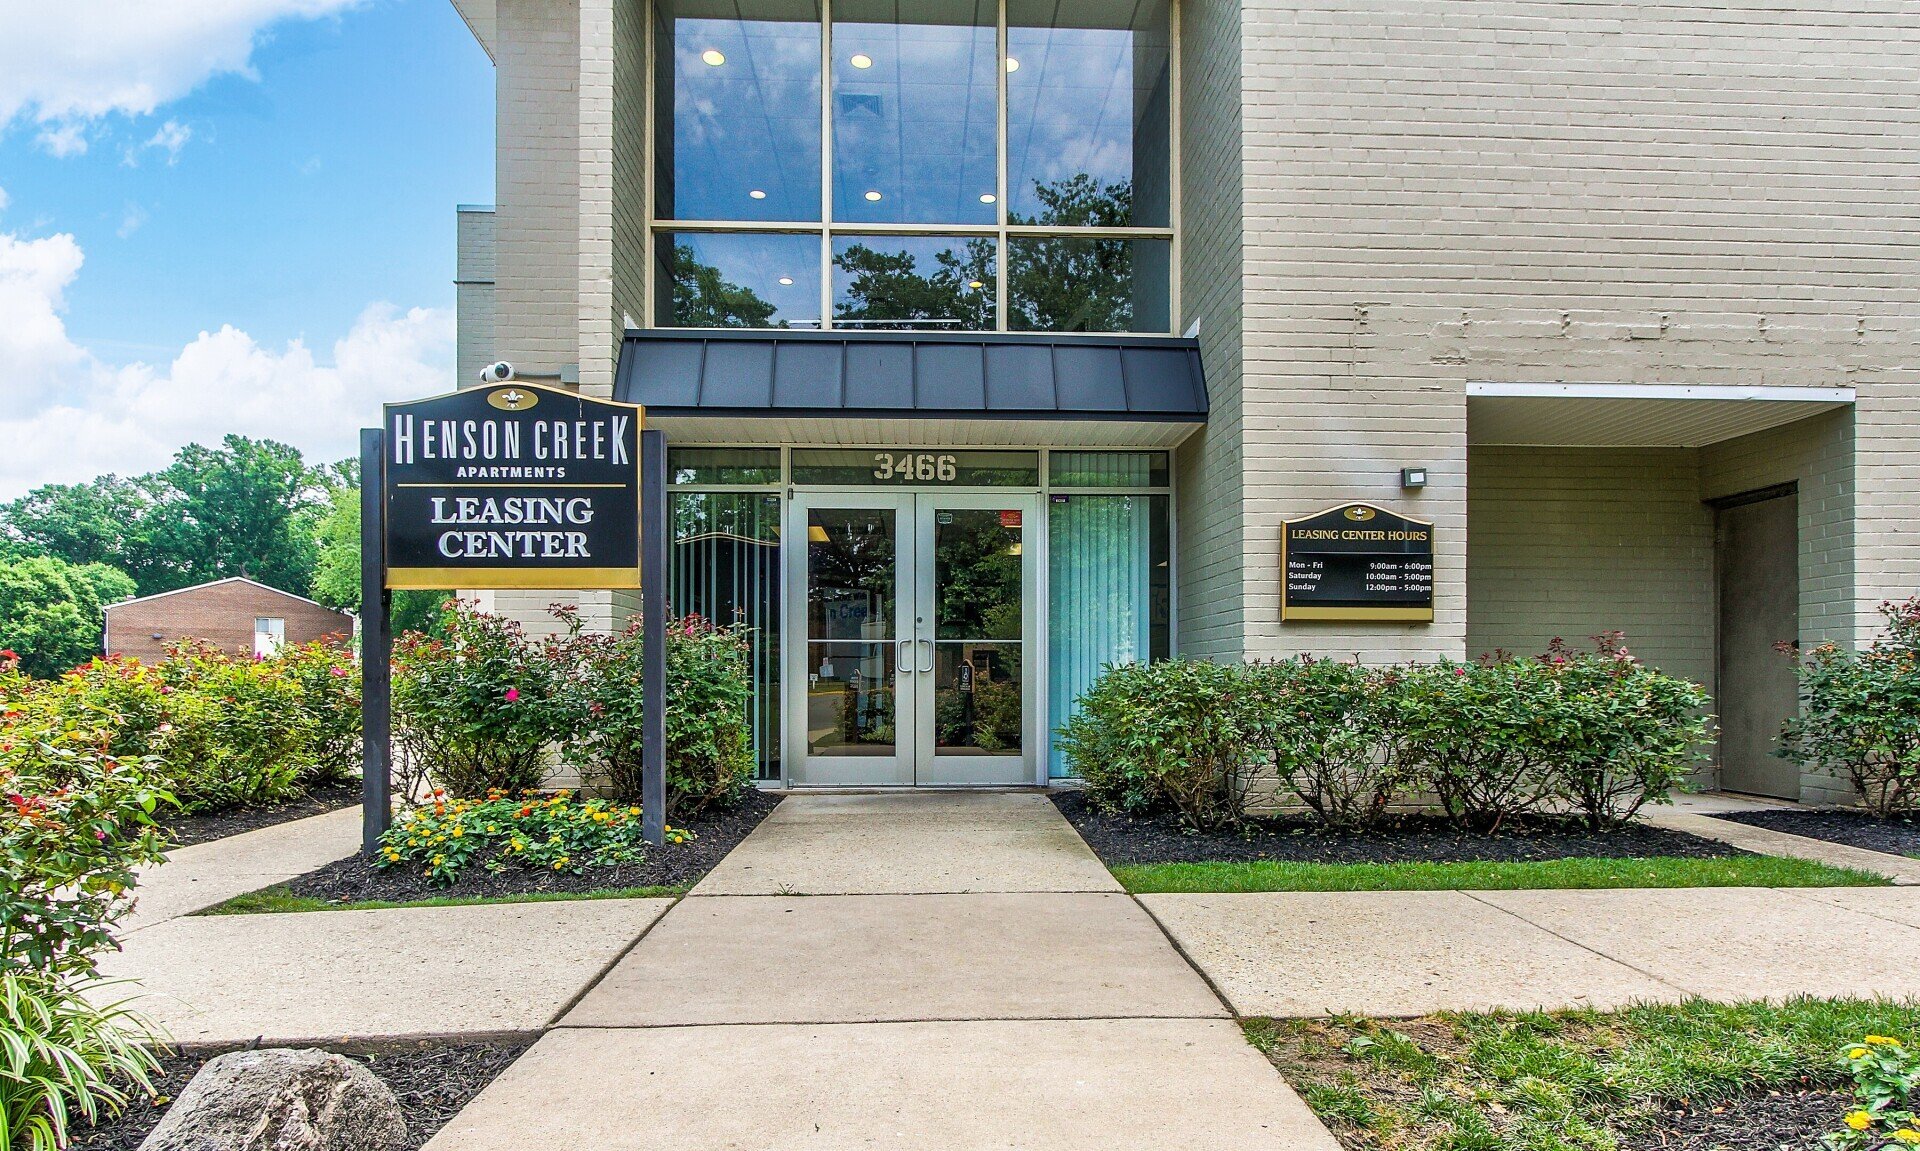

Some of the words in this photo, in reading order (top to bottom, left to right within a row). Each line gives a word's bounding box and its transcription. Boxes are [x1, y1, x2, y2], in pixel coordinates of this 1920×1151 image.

[395, 414, 520, 464] HENSON
[534, 415, 629, 465] CREEK
[456, 466, 566, 478] APARTMENTS
[873, 453, 956, 481] 3466
[431, 497, 595, 524] LEASING
[1292, 529, 1339, 540] LEASING
[1341, 530, 1385, 541] CENTER
[1387, 530, 1428, 541] HOURS
[438, 530, 591, 558] CENTER
[1288, 561, 1306, 569] Mon
[1312, 561, 1324, 569] Fri
[1369, 562, 1398, 570] 9:00am
[1404, 562, 1432, 571] 6:00pm
[1288, 571, 1322, 581] Saturday
[1404, 573, 1432, 582] 5:00pm
[1288, 582, 1317, 592] Sunday
[1366, 583, 1397, 592] 12:00pm
[1404, 584, 1432, 592] 5:00pm
